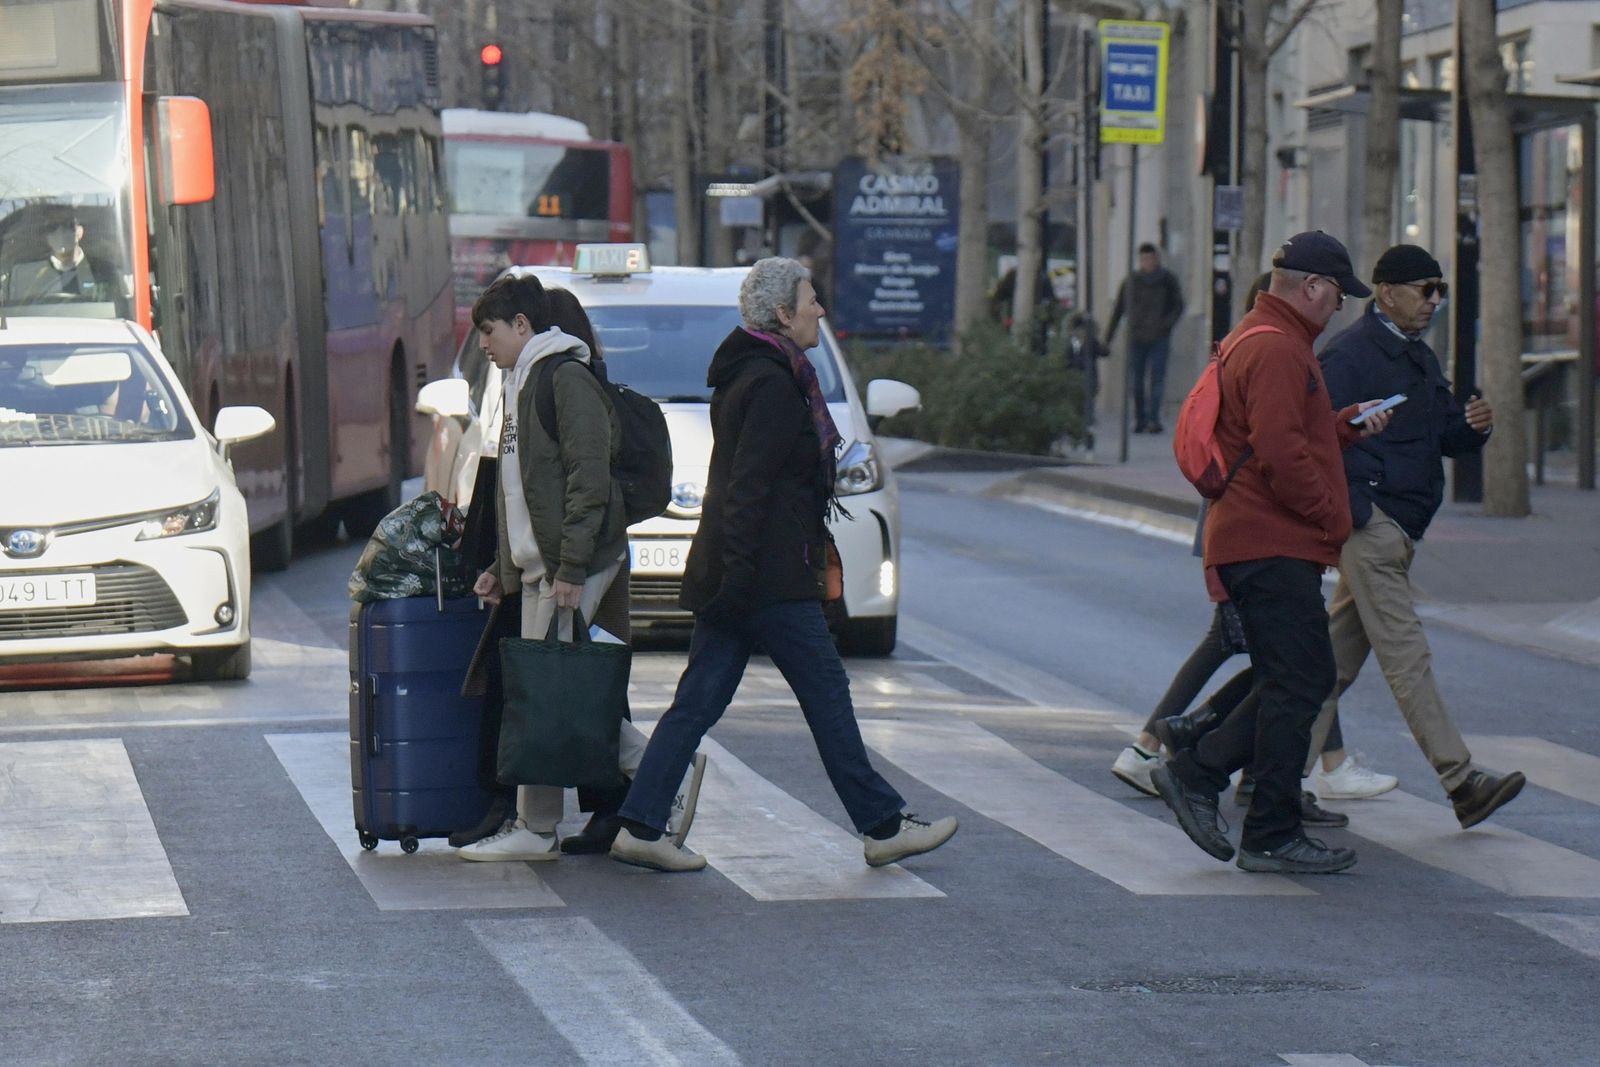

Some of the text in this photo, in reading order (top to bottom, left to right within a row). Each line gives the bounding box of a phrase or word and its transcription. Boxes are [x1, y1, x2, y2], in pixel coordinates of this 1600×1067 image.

[1112, 83, 1151, 102] TAXI
[859, 174, 940, 195] CASINO
[537, 194, 561, 215] 11
[850, 195, 948, 216] ADMIRAL
[590, 248, 641, 268] TAXI 2
[639, 547, 680, 567] 808
[45, 578, 87, 601] LTT
